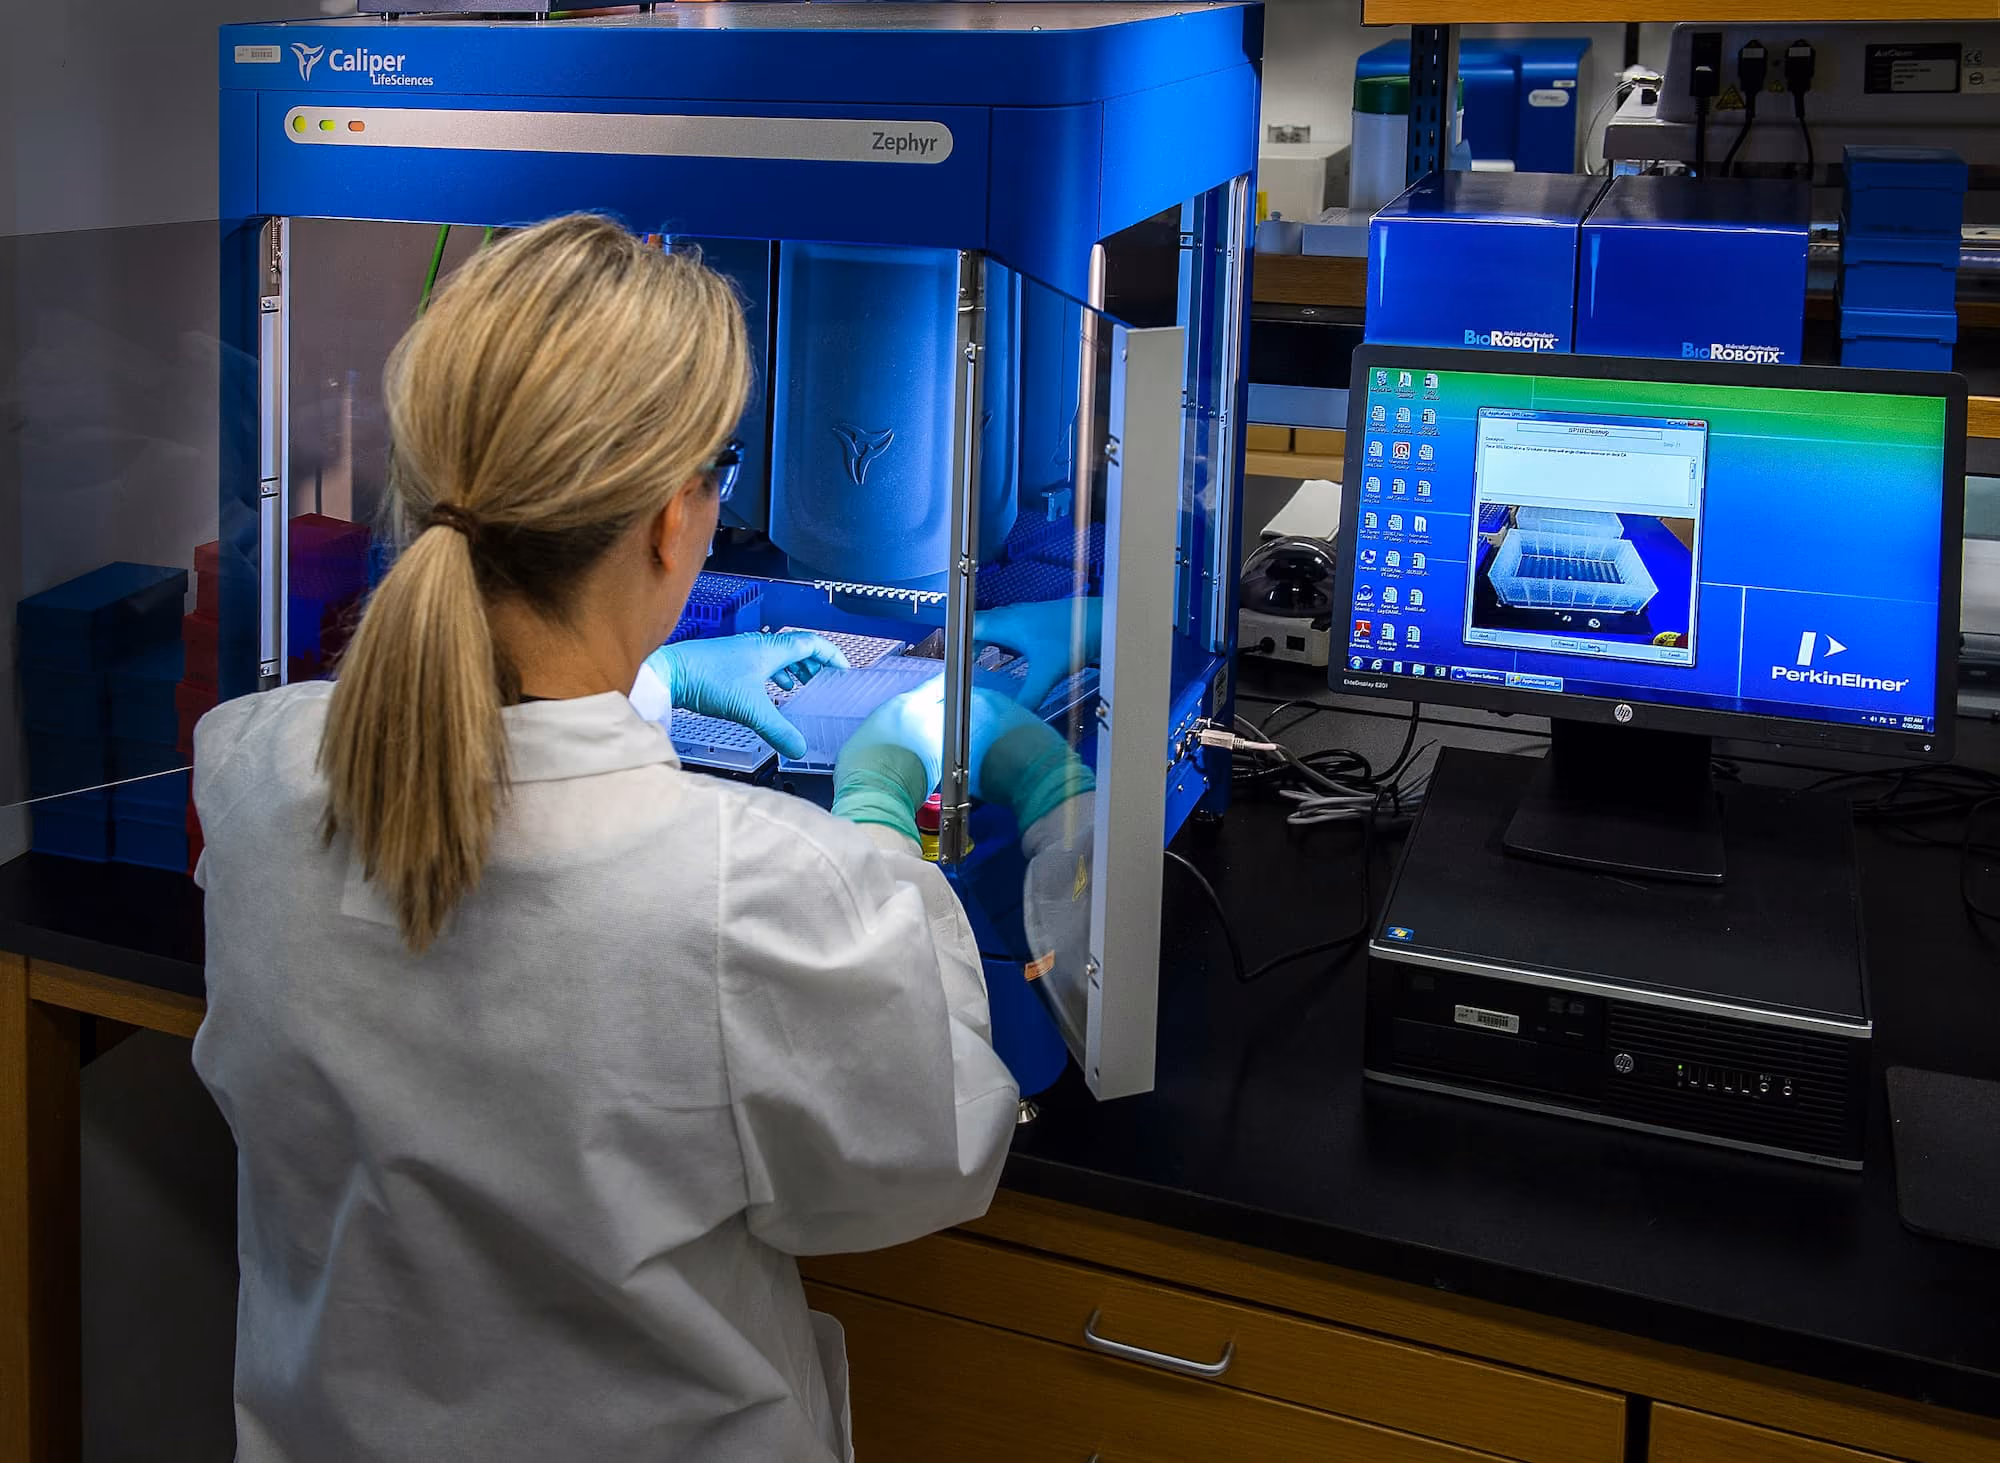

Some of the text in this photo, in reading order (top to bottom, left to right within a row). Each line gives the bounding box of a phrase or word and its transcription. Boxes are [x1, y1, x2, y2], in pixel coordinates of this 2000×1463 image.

[328, 47, 406, 78] Caliper
[371, 73, 434, 87] LifeSciences
[872, 132, 938, 155] Zephyr
[1771, 665, 1907, 692] PerkinElmer
